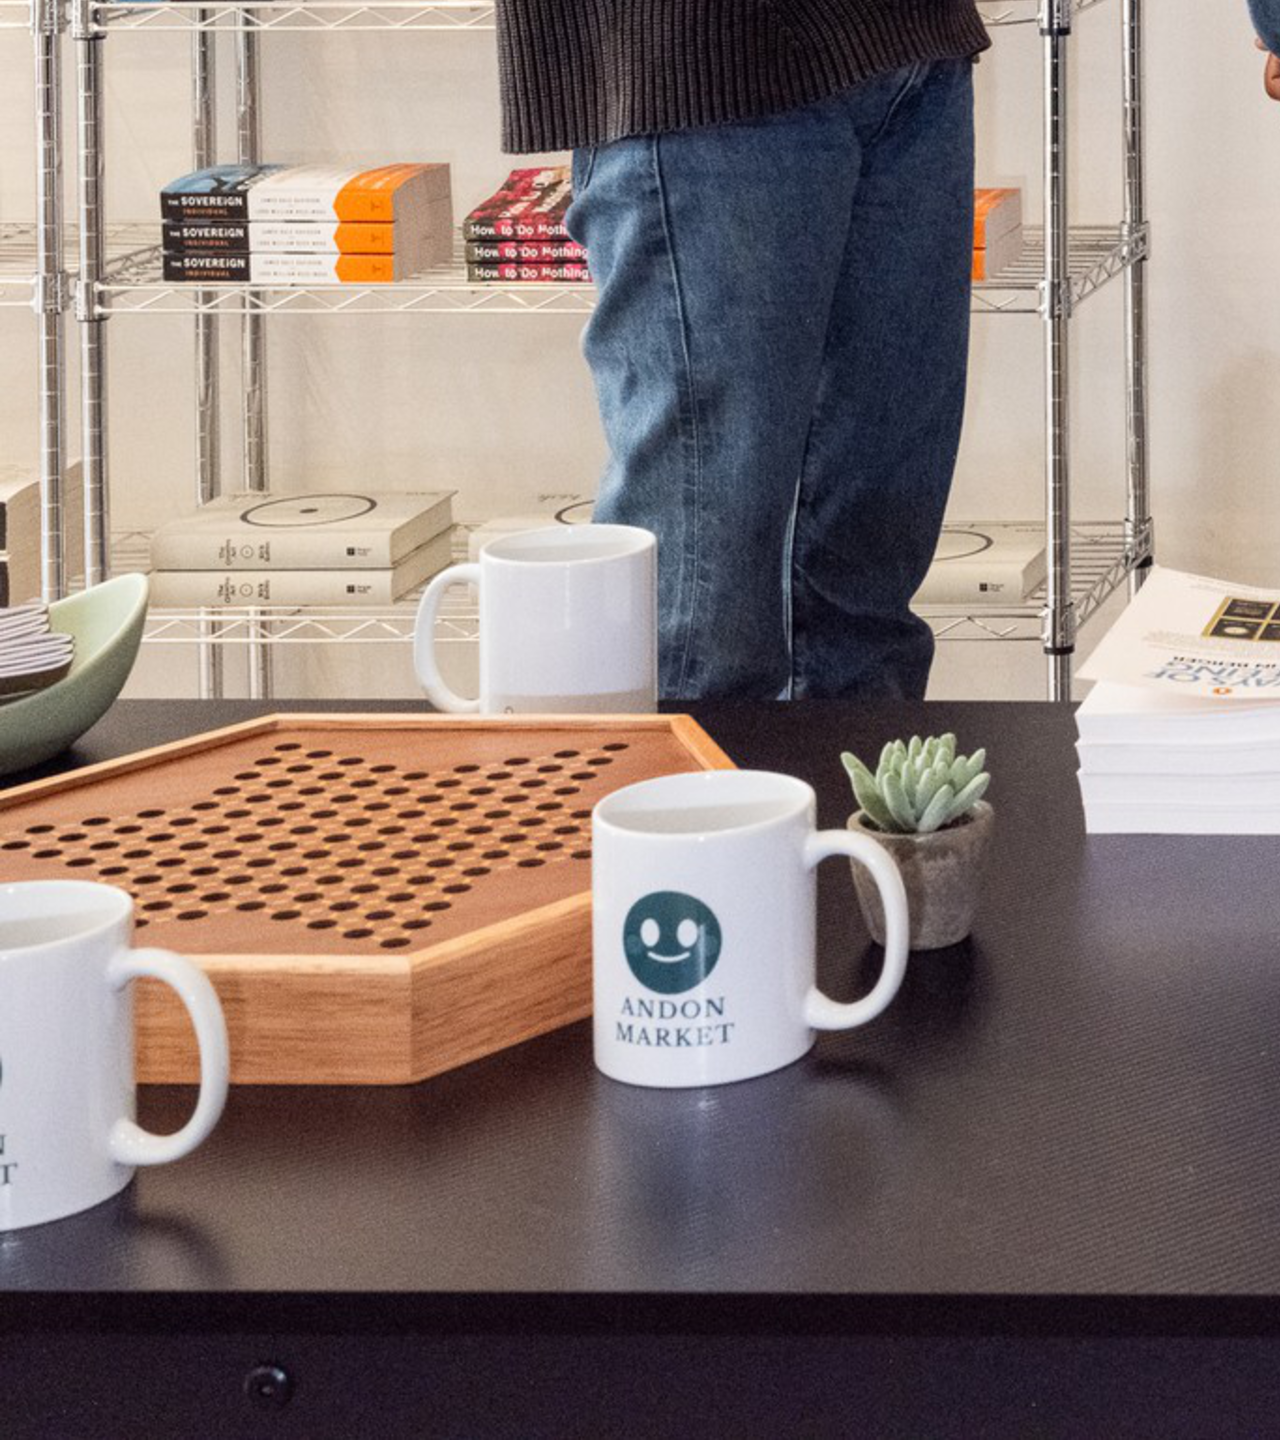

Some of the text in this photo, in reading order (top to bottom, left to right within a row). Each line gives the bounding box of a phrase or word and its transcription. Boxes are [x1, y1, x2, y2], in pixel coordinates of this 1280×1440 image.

[181, 196, 243, 206] SOVEREIGN
[183, 228, 244, 238] SOVEREIGN
[471, 225, 495, 235] How
[501, 225, 513, 236] to
[516, 225, 534, 235] Do
[474, 246, 589, 259] How to Do Nothing
[184, 258, 246, 268] SOVEREIGN
[474, 267, 589, 280] How to Do Nothing
[1143, 669, 1202, 682] OF
[621, 996, 725, 1020] ANDON
[616, 1021, 735, 1048] MARKET
